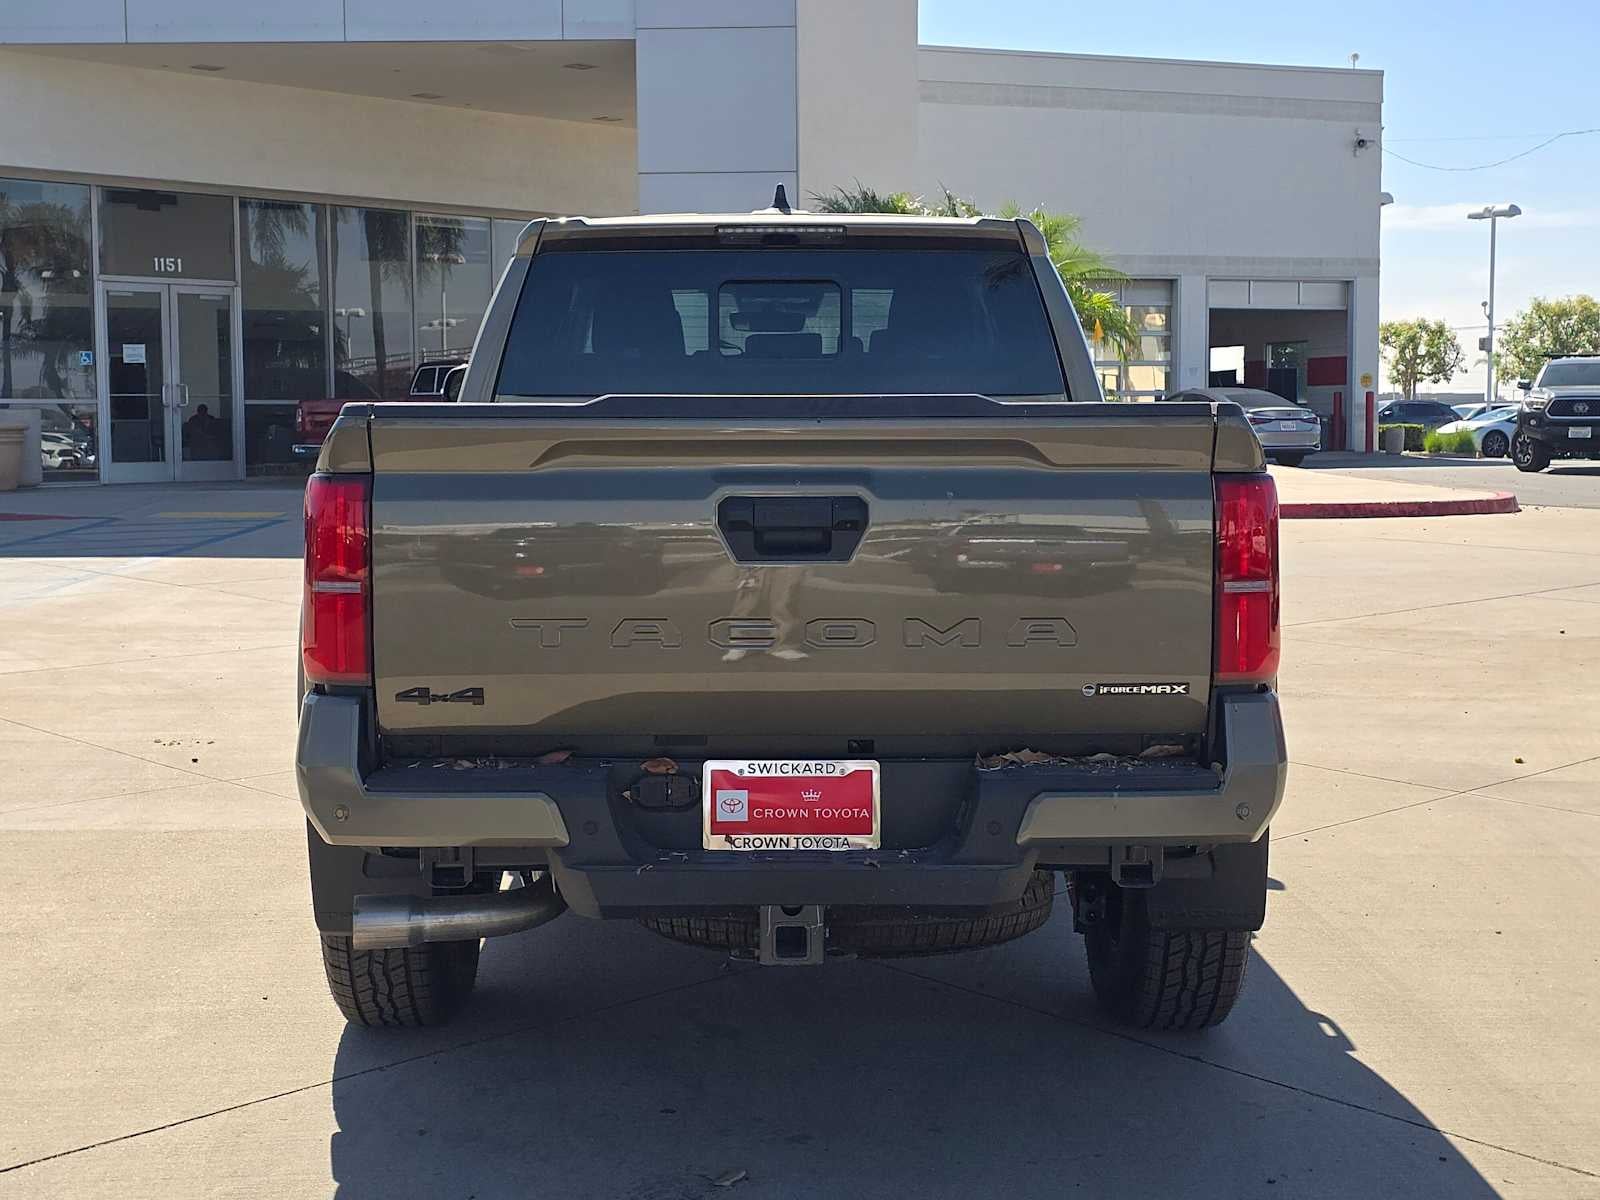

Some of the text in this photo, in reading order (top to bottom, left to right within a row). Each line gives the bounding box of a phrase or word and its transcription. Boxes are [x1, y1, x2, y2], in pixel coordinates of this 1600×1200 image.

[154, 257, 182, 272] 1151
[509, 616, 1078, 648] TACOMA
[747, 763, 836, 775] SWICKARD
[753, 808, 870, 819] CROWN TOYOTA
[732, 837, 851, 850] CROWN TOYOTA
